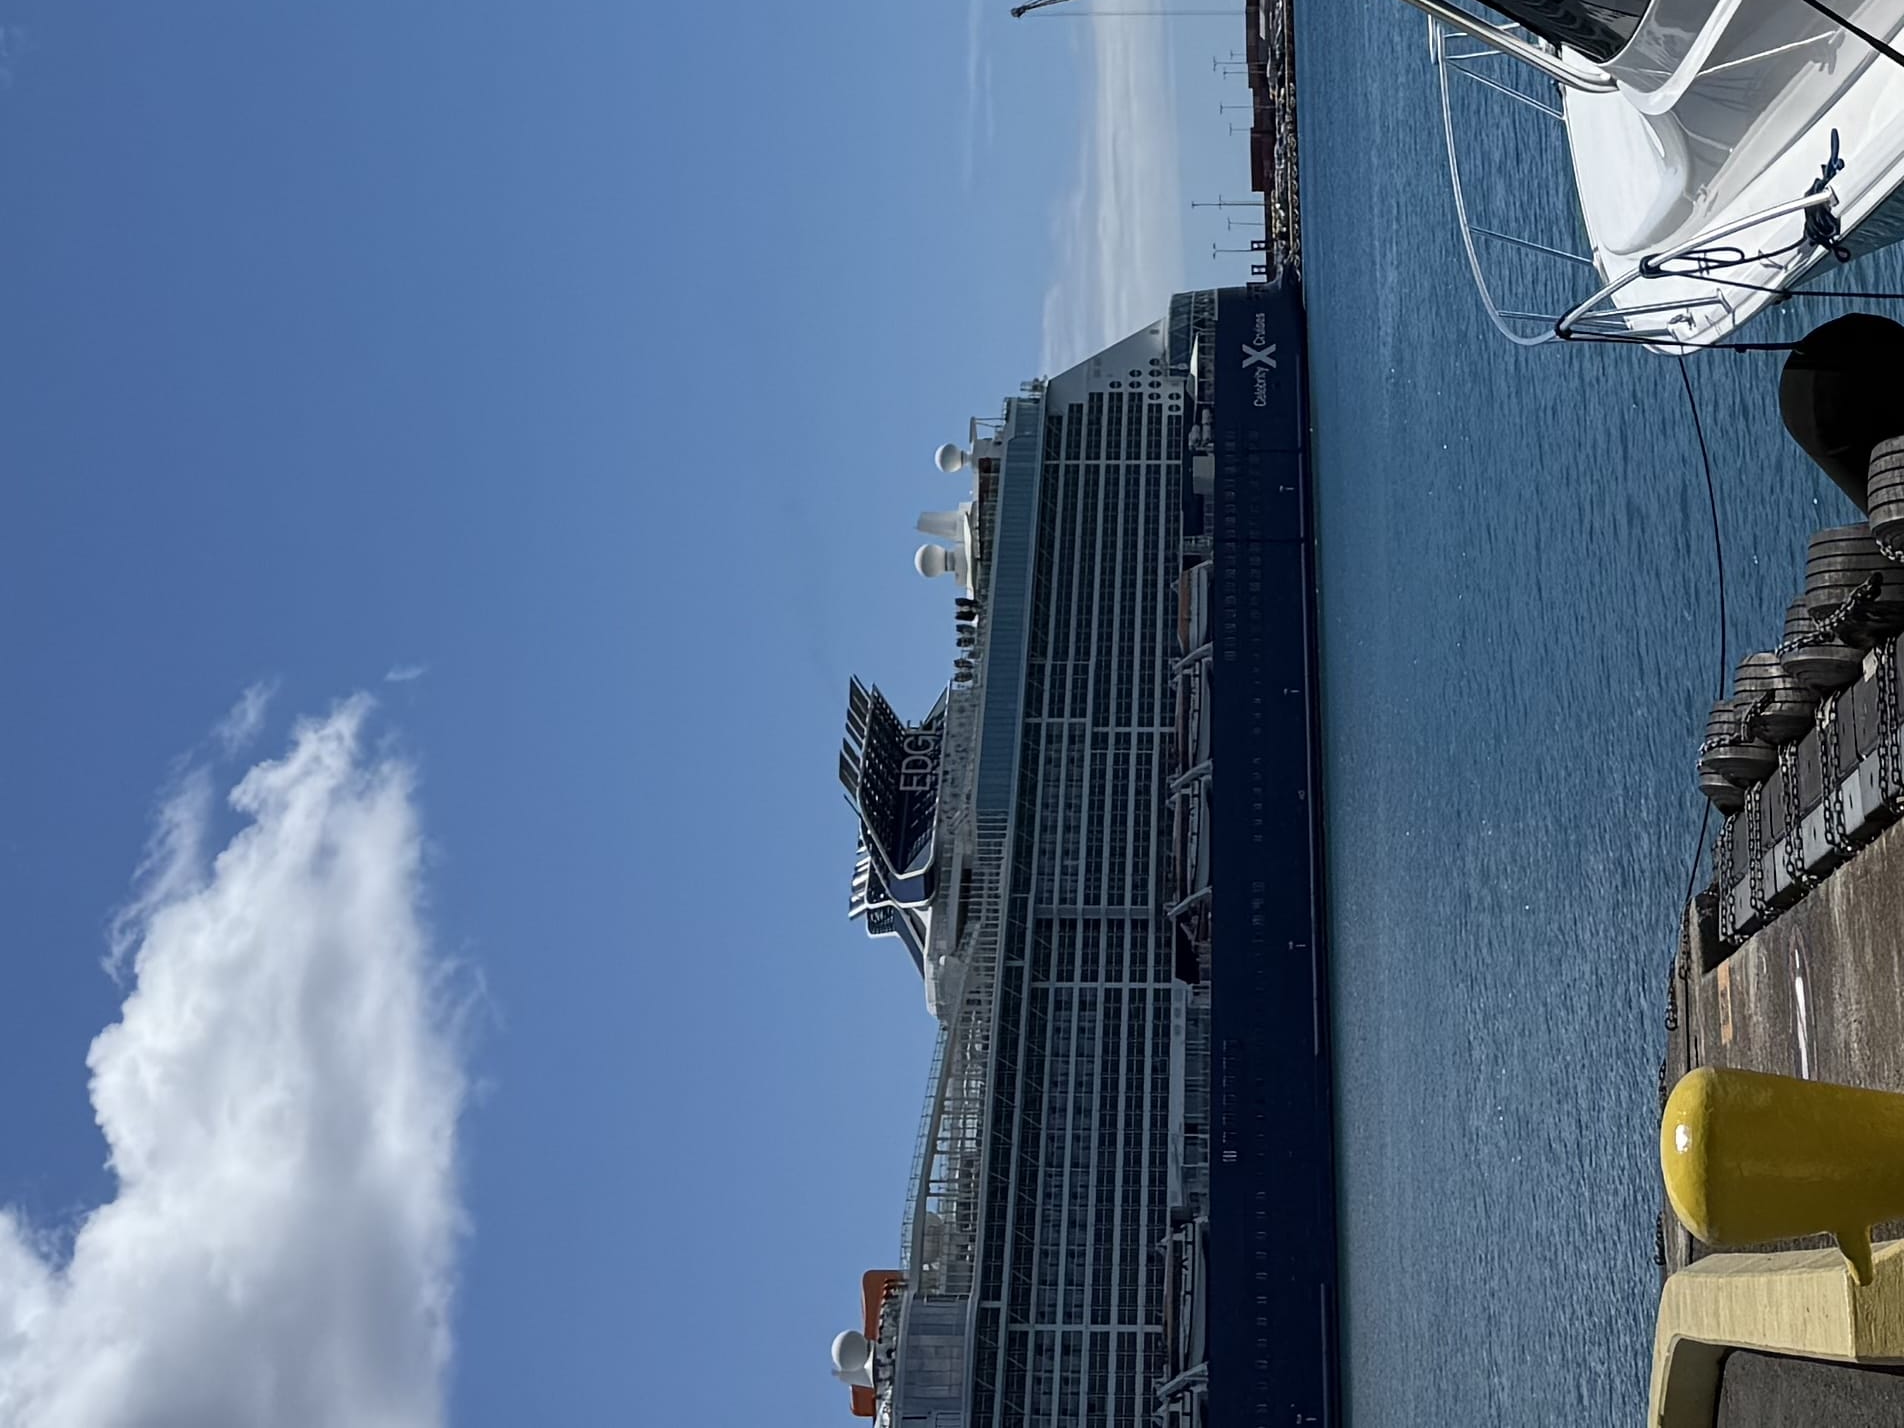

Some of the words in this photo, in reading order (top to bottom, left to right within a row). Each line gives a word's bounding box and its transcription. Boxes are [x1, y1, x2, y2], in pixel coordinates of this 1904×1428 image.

[1252, 312, 1266, 346] Cruises
[1253, 367, 1270, 407] Celebrity
[899, 719, 938, 791] EDGE
